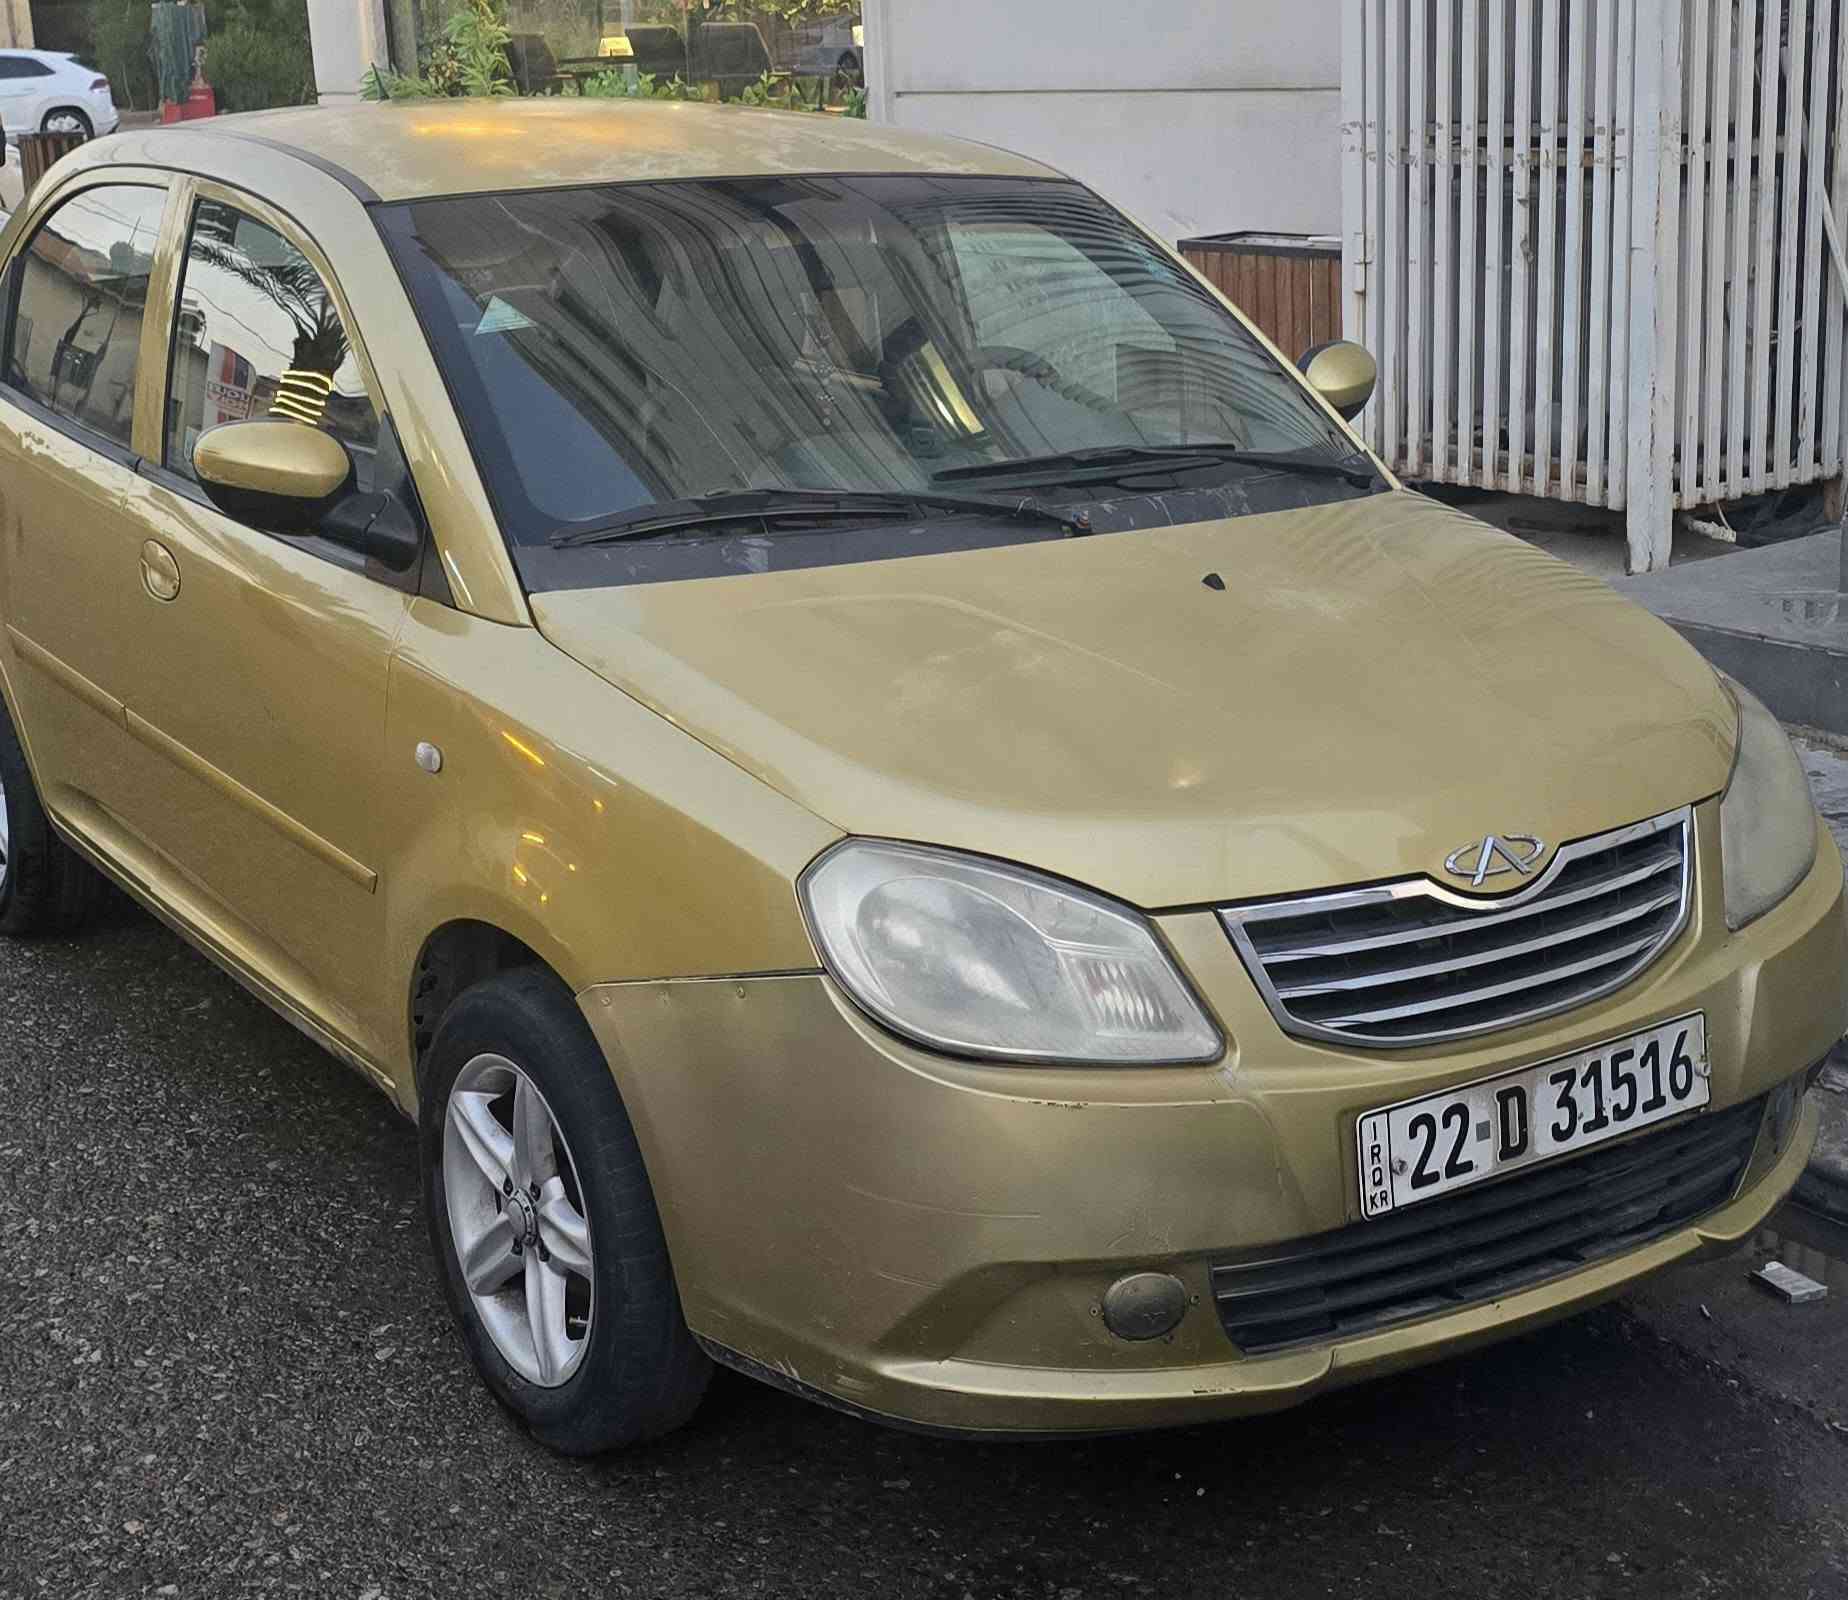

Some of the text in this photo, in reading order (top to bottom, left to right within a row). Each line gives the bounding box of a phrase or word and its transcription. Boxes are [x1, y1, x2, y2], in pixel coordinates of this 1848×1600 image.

[1408, 1029, 1694, 1190] 22 D 31516
[1369, 1189, 1389, 1210] KR
